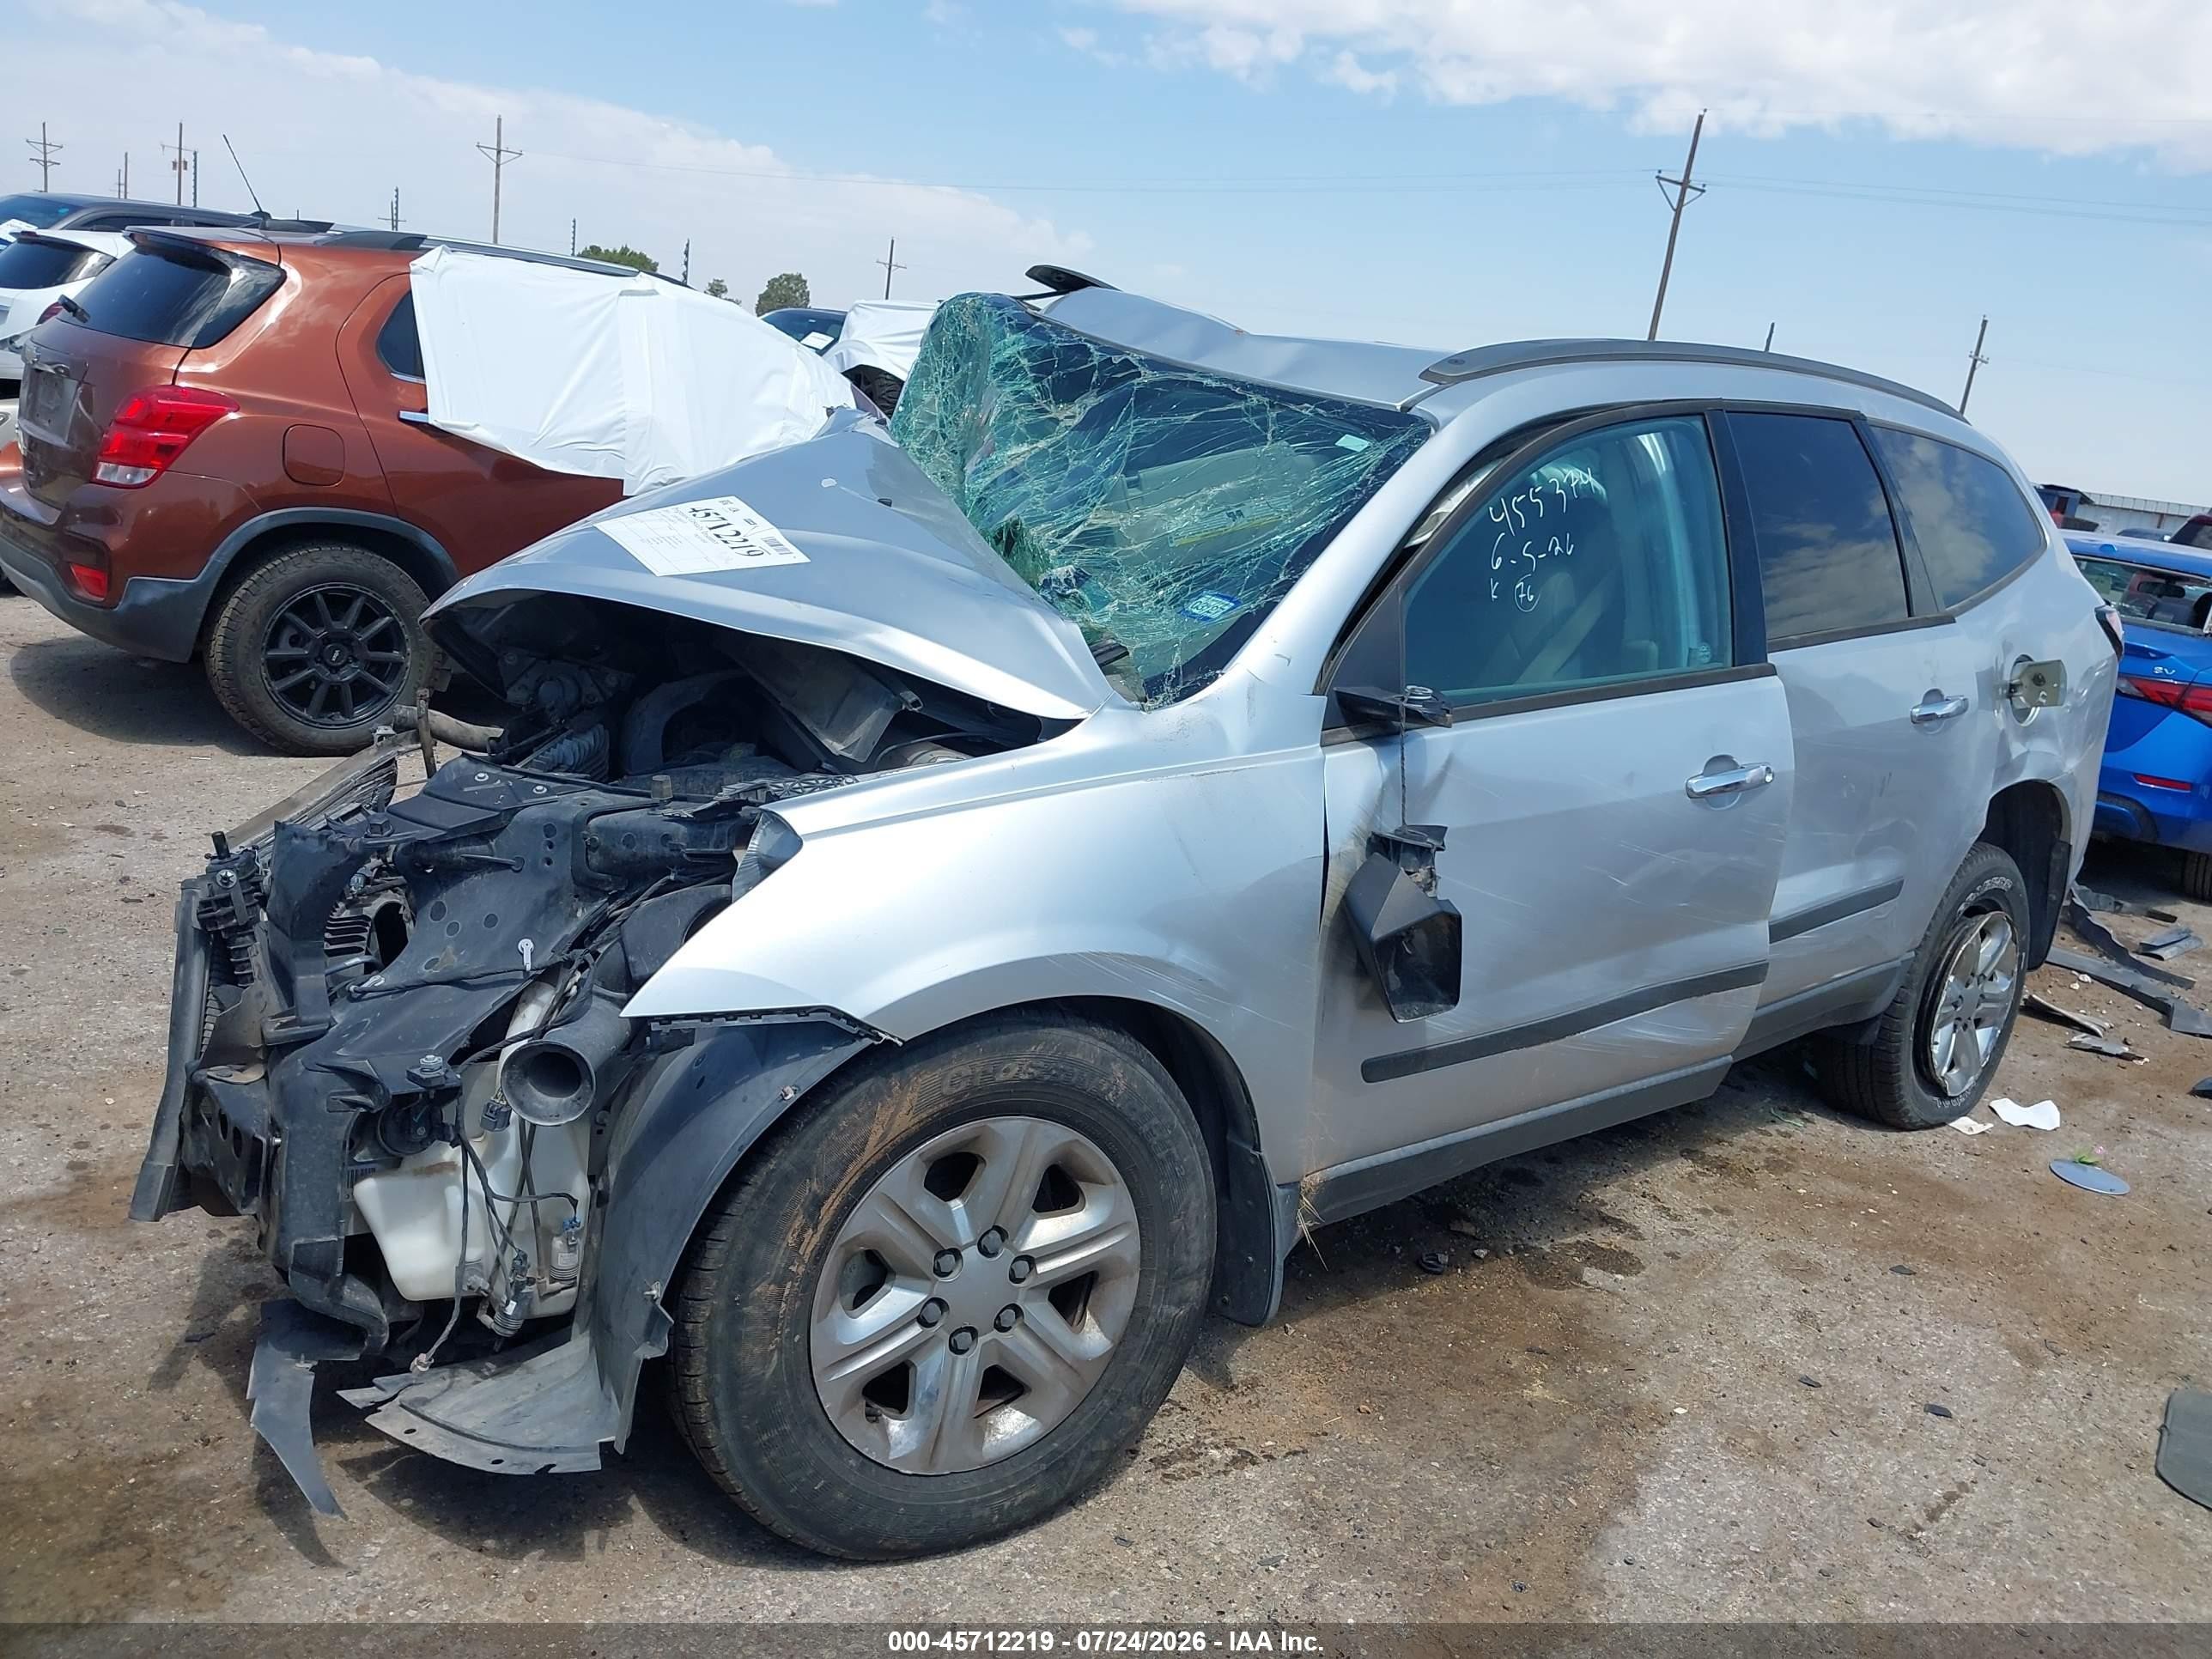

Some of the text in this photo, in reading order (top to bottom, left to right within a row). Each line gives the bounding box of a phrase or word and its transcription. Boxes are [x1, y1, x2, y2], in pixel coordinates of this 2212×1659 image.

[687, 506, 765, 558] 45712219
[1490, 532, 1575, 572] 6-5-26
[2153, 666, 2177, 676] SV
